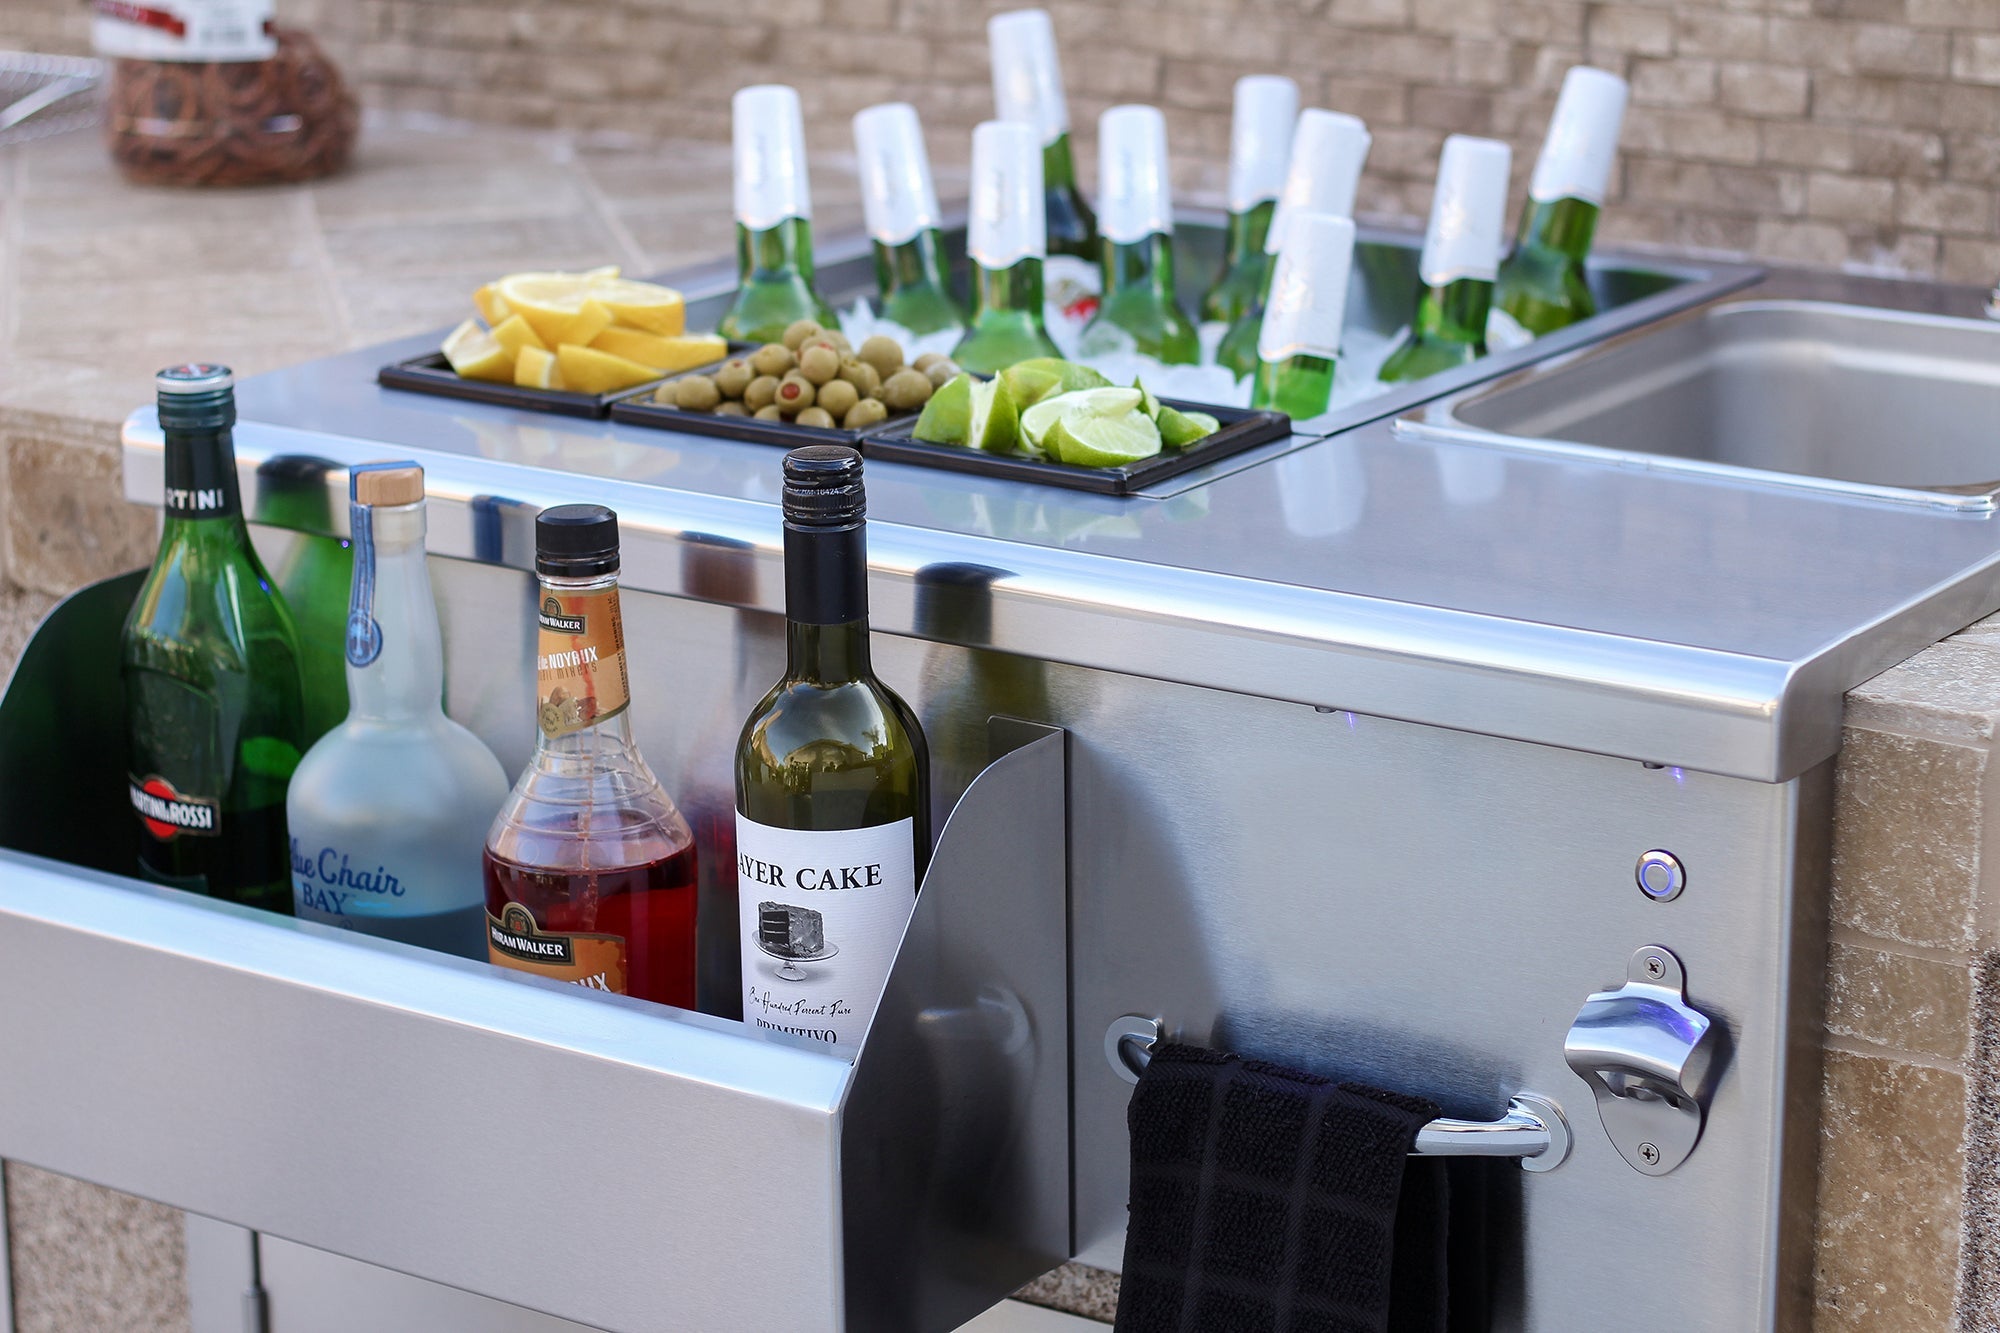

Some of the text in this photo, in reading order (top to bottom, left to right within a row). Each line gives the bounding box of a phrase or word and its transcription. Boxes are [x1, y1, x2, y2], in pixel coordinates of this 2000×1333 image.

[550, 617, 581, 630] WALKER
[549, 646, 598, 670] NOYAUX
[318, 847, 406, 897] Chair
[738, 851, 883, 891] AYER CAKE
[302, 882, 346, 916] BAY
[490, 926, 517, 949] HIRAM
[516, 937, 565, 957] WALKER
[760, 991, 793, 1015] Hundred
[793, 998, 827, 1017] Percent
[829, 999, 852, 1018] Pure
